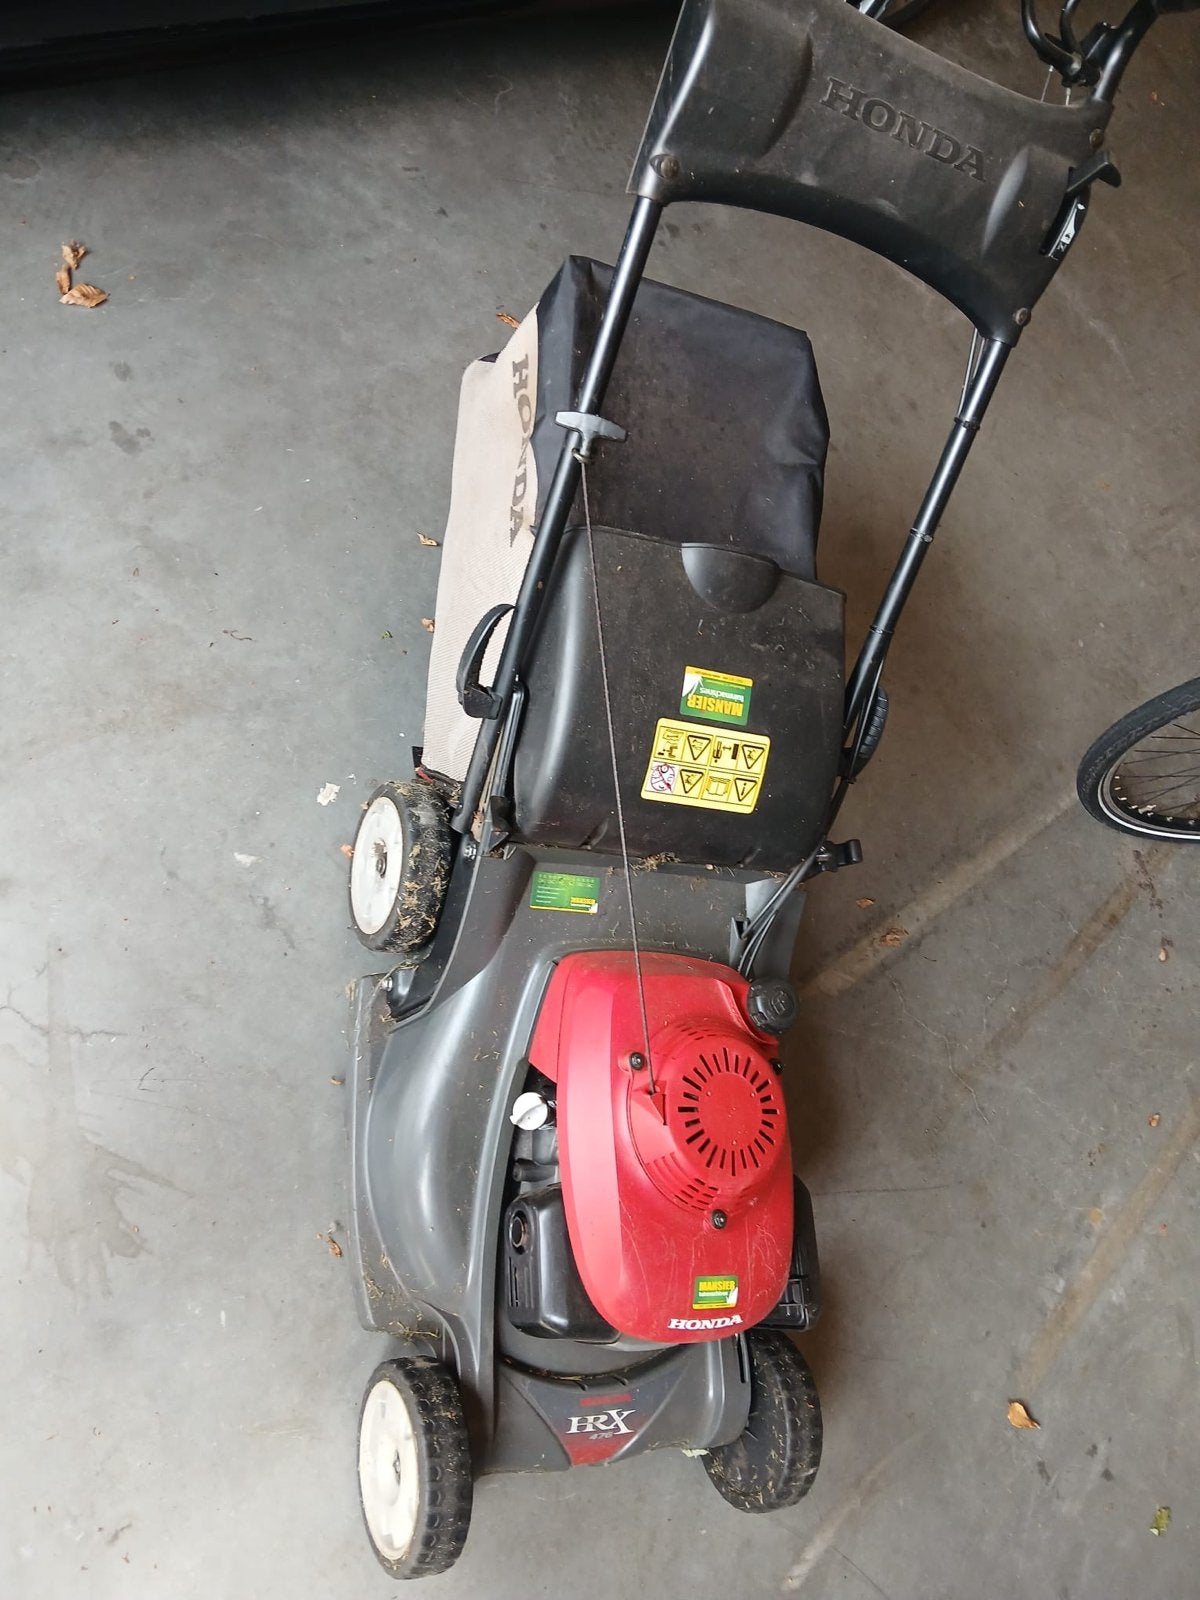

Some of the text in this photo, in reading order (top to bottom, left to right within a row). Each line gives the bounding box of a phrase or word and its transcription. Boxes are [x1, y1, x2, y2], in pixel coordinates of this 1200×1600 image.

[819, 76, 986, 182] HONDA
[511, 353, 532, 548] HONDA
[687, 694, 744, 716] MANSIER
[699, 1281, 735, 1291] MANSIER
[668, 1315, 743, 1330] HONDA
[565, 1408, 636, 1435] HRX
